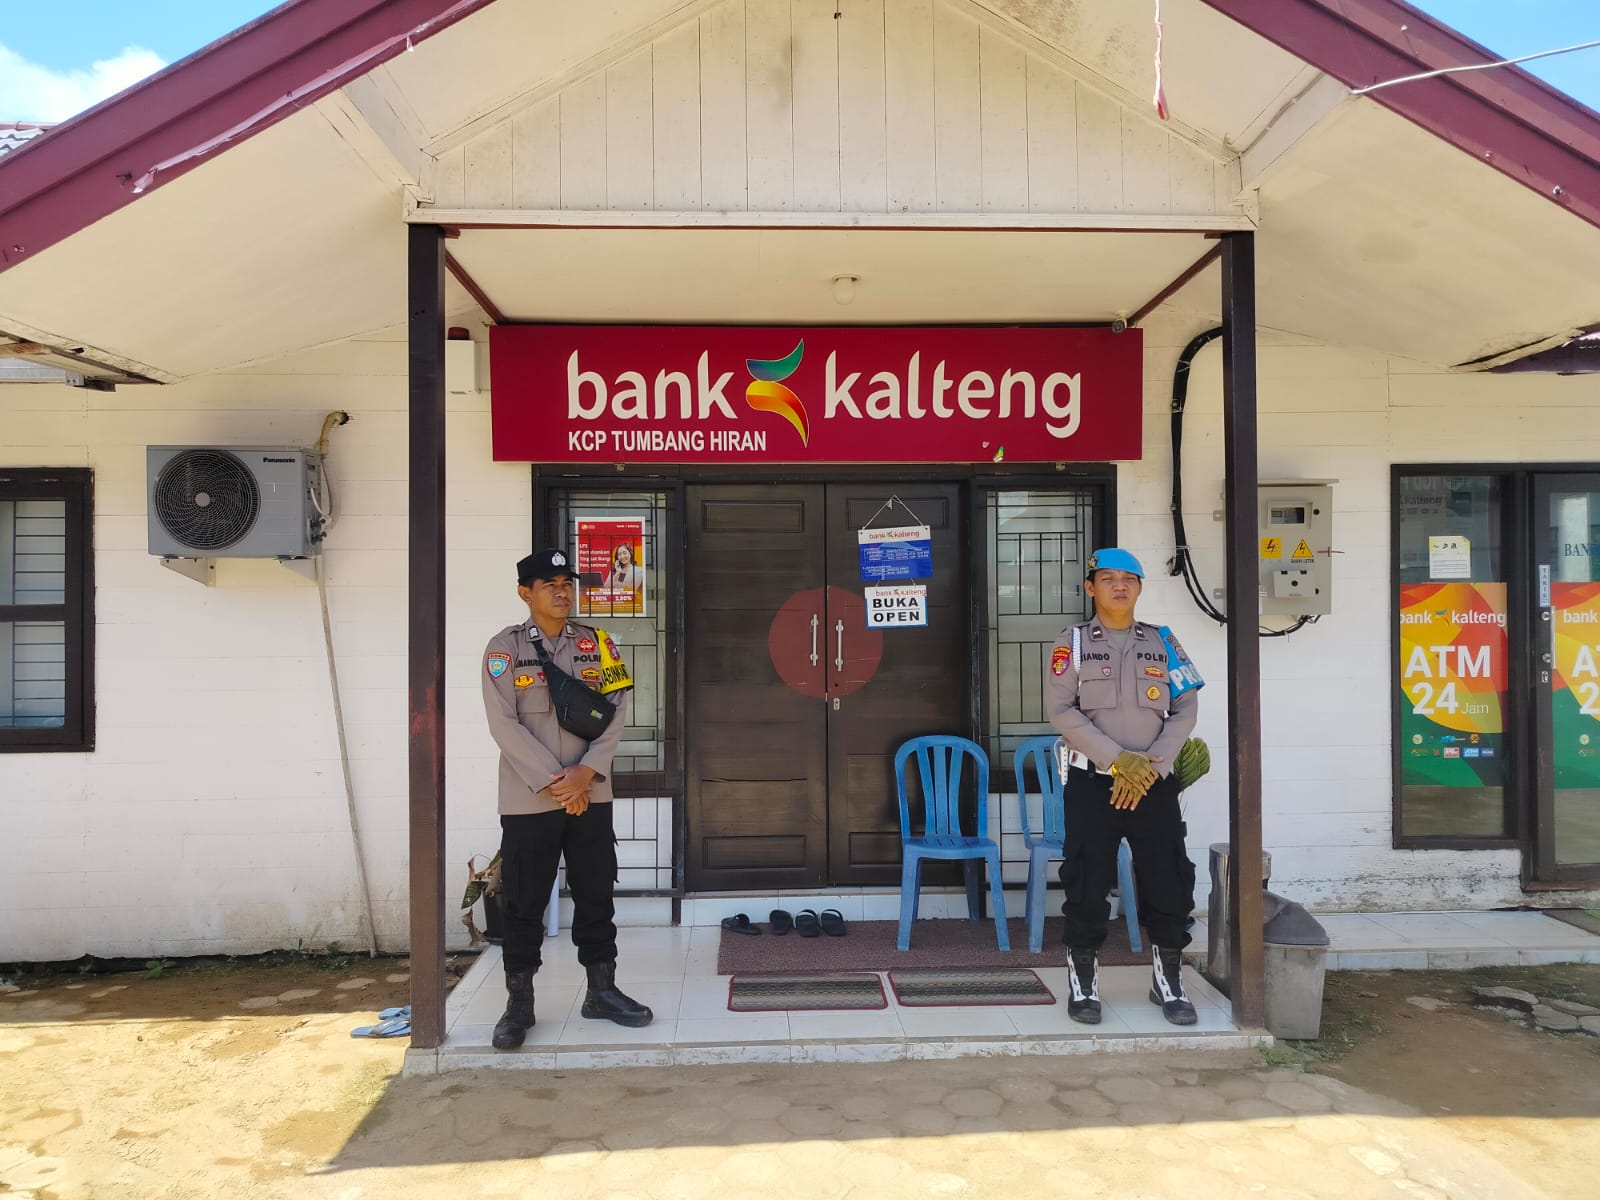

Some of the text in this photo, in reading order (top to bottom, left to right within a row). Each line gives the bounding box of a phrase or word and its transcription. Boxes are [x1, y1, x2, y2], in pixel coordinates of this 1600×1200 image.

[567, 350, 1081, 439] bank kalteng
[568, 431, 766, 451] KCP TUMBANG HIRAN
[869, 530, 920, 540] bank kalteng
[875, 588, 927, 597] bank kalteng
[872, 597, 919, 609] BUKA
[873, 611, 920, 623] OPEN
[1452, 609, 1506, 627] kalteng
[1563, 609, 1598, 623] bank
[573, 654, 601, 663] POLRI
[1136, 652, 1168, 663] POLRI
[1405, 645, 1491, 678] ATM
[1412, 682, 1489, 715] 24 Jam
